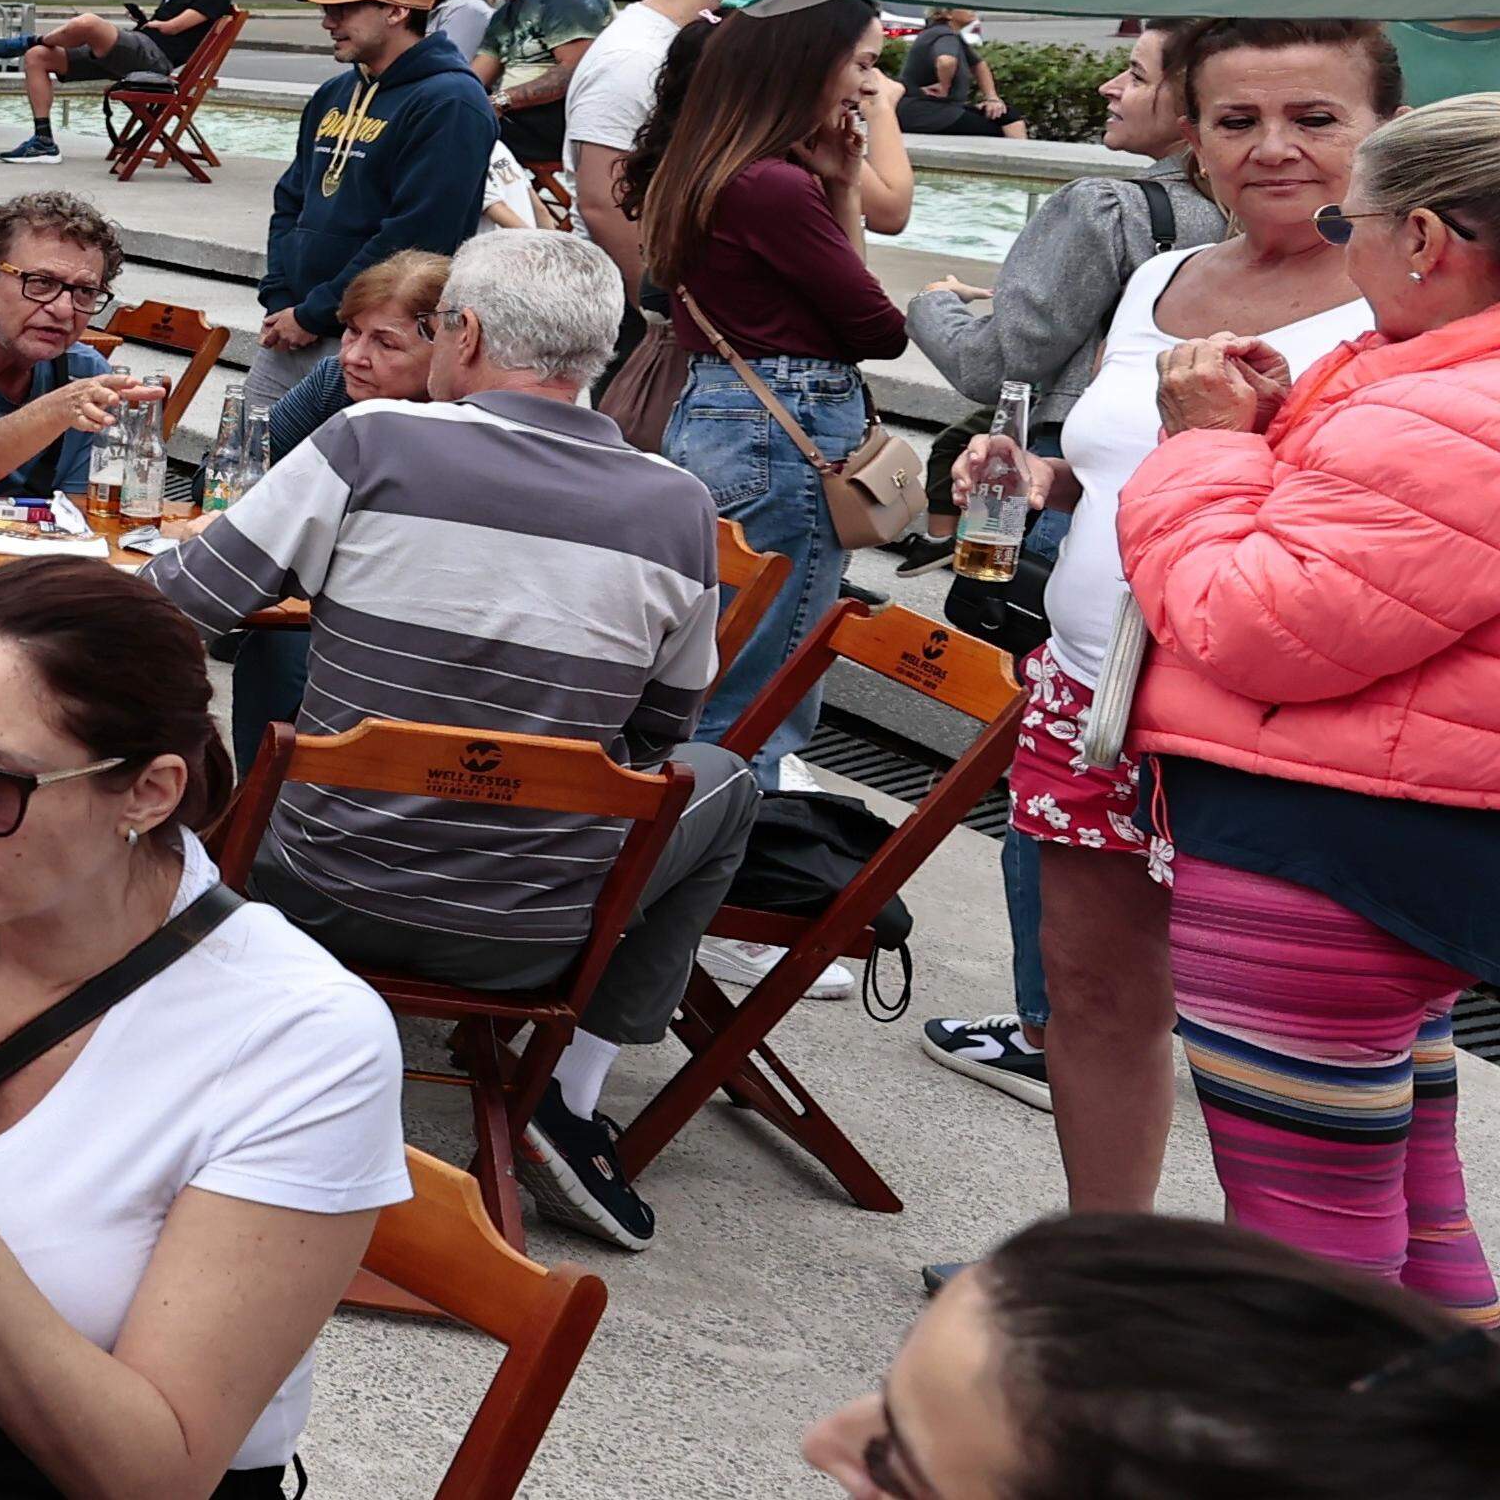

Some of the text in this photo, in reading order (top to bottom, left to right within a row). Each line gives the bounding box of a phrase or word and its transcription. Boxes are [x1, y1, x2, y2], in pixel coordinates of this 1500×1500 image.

[208, 469, 233, 481] RAY
[428, 768, 465, 781] WELL
[469, 774, 522, 789] FESTAS
